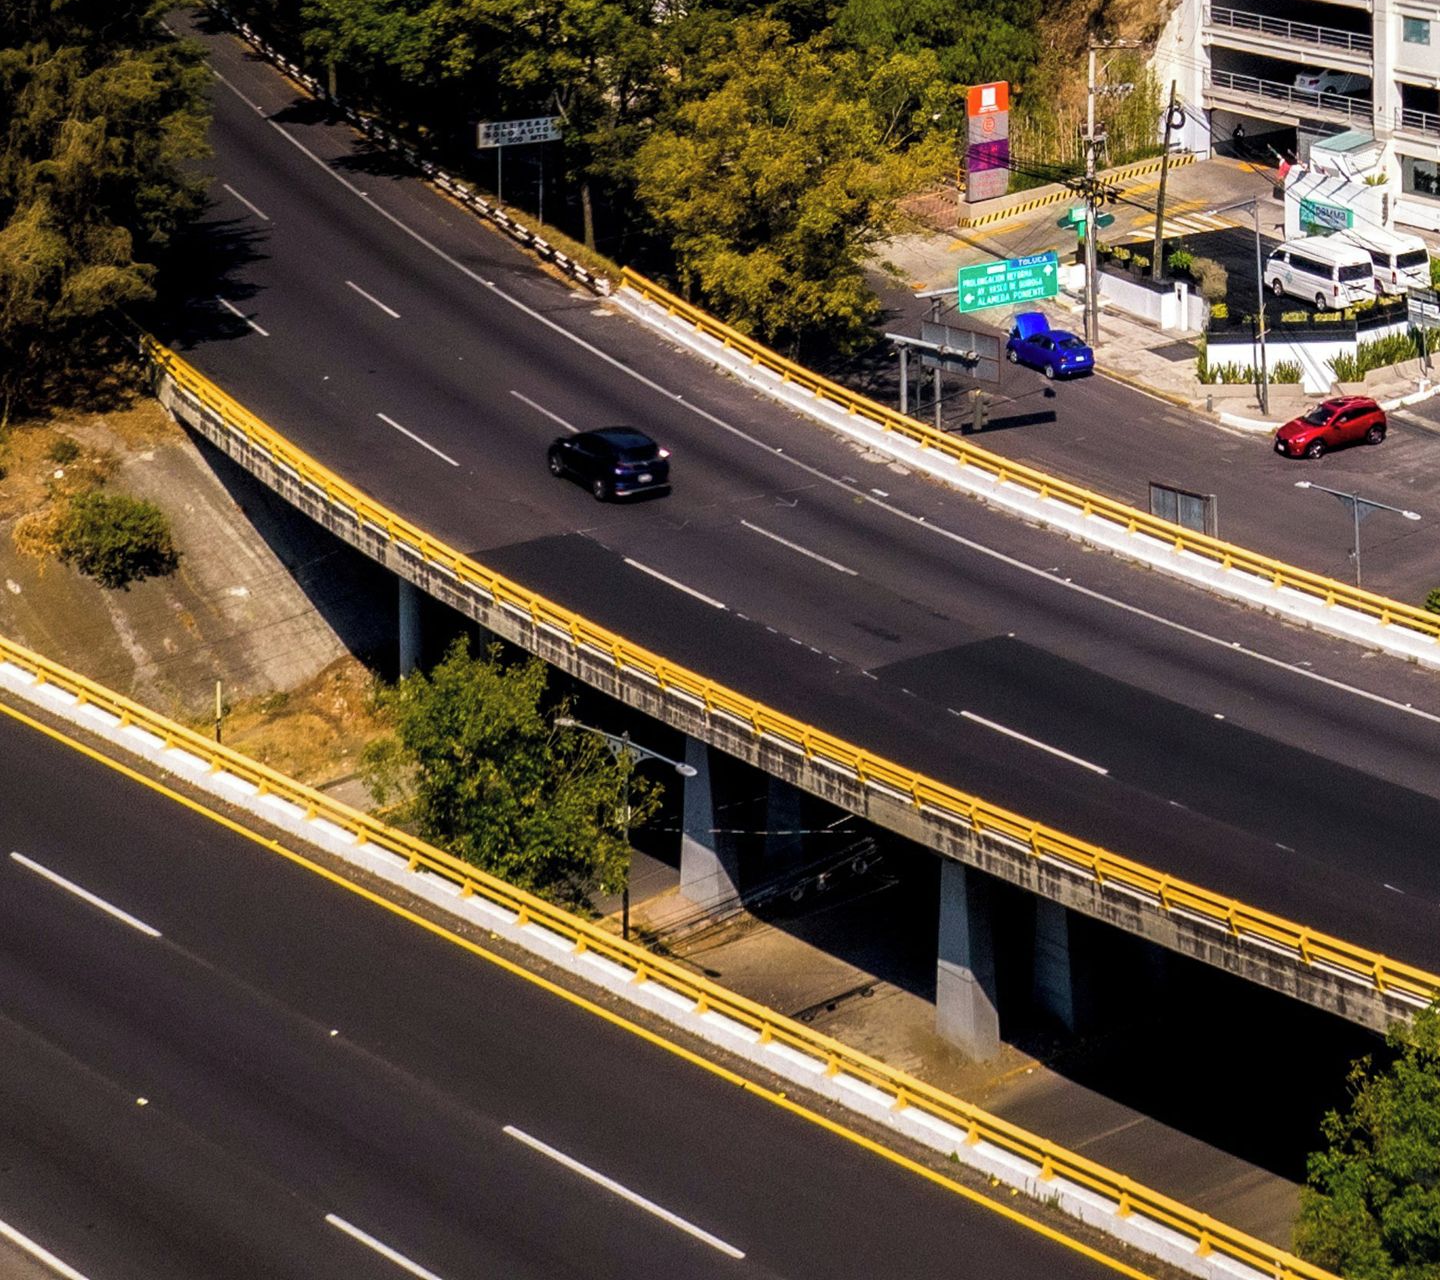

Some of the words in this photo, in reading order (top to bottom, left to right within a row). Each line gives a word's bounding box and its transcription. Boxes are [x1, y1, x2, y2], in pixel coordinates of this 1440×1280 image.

[484, 130, 514, 138] SOLO
[1018, 255, 1048, 266] TOLUCA
[977, 292, 1010, 306] ALAMEDA
[1013, 287, 1045, 300] PONIENTE
